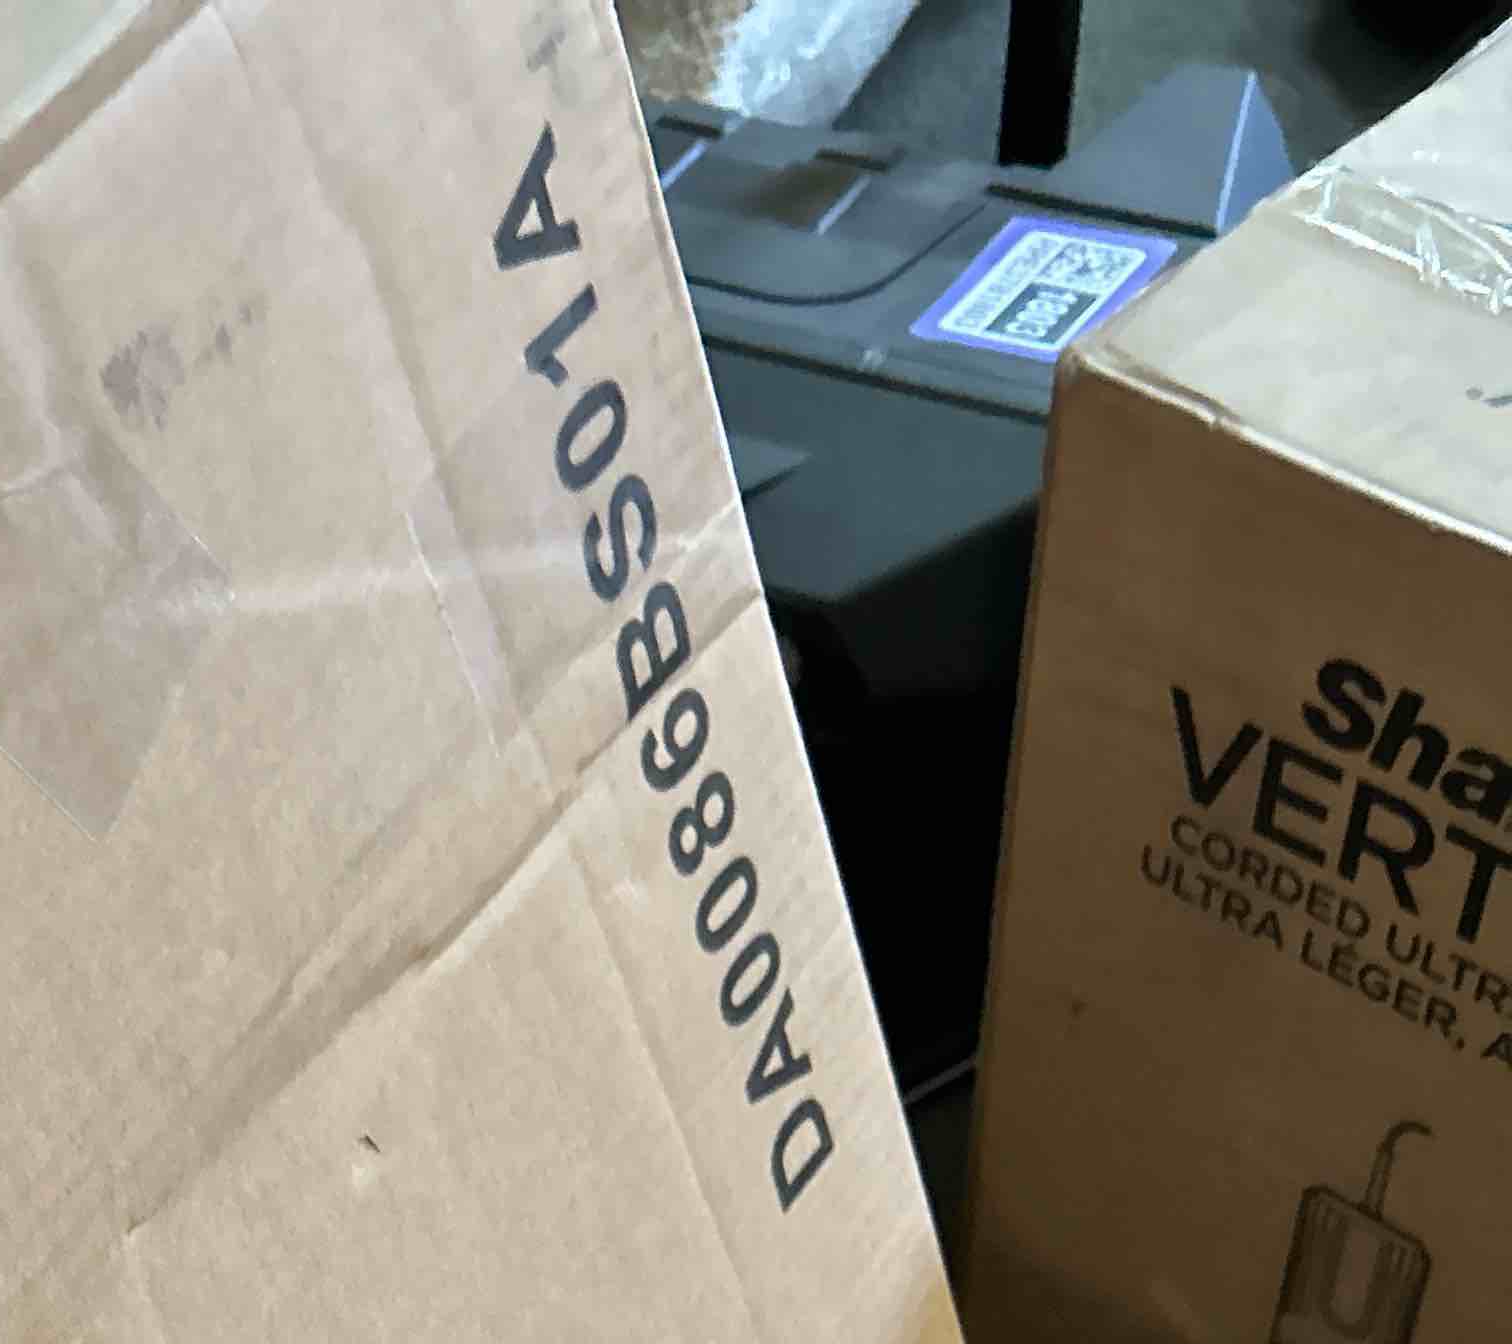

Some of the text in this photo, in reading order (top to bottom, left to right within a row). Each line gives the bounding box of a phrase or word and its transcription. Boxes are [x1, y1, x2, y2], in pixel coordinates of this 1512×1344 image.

[493, 122, 835, 1215] DA0086BS01A
[1301, 658, 1512, 824] Sha
[1140, 844, 1285, 952] ULTRA
[1170, 815, 1512, 1022] CORDED ULTR
